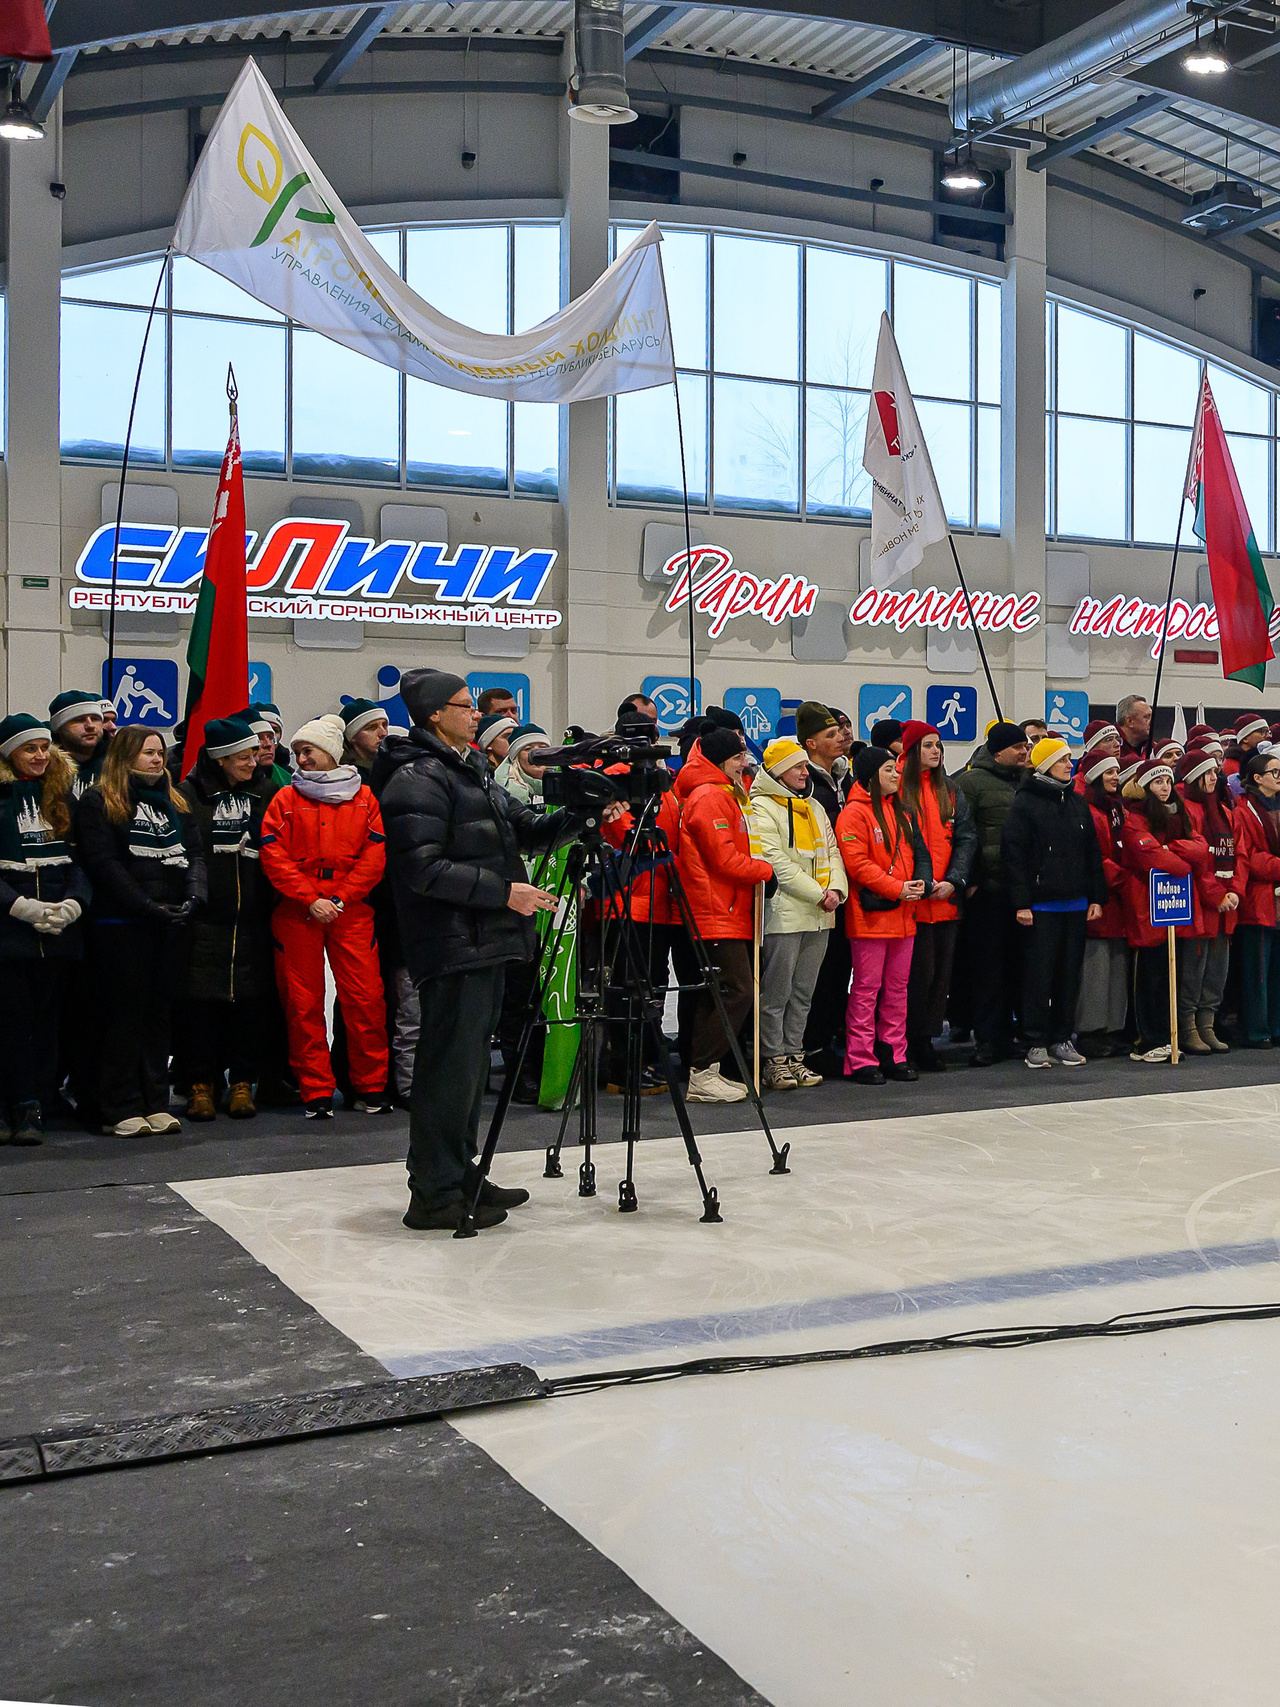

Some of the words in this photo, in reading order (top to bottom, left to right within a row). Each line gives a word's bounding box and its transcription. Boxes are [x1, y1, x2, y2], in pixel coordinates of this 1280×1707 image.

[271, 247, 371, 316] УПРАВЛЕНИЯ
[369, 312, 429, 351] ДЕЛАМ
[873, 479, 903, 507] ОМБИНАТ
[664, 546, 819, 637] Дарим
[851, 588, 1040, 632] отличное
[73, 592, 313, 616] РЕСПУБЛИСКИЙ
[319, 604, 490, 623] ГОРНОЛЫЖНЫЙ
[495, 611, 558, 627] ЦЕНТР
[675, 699, 698, 716] 24
